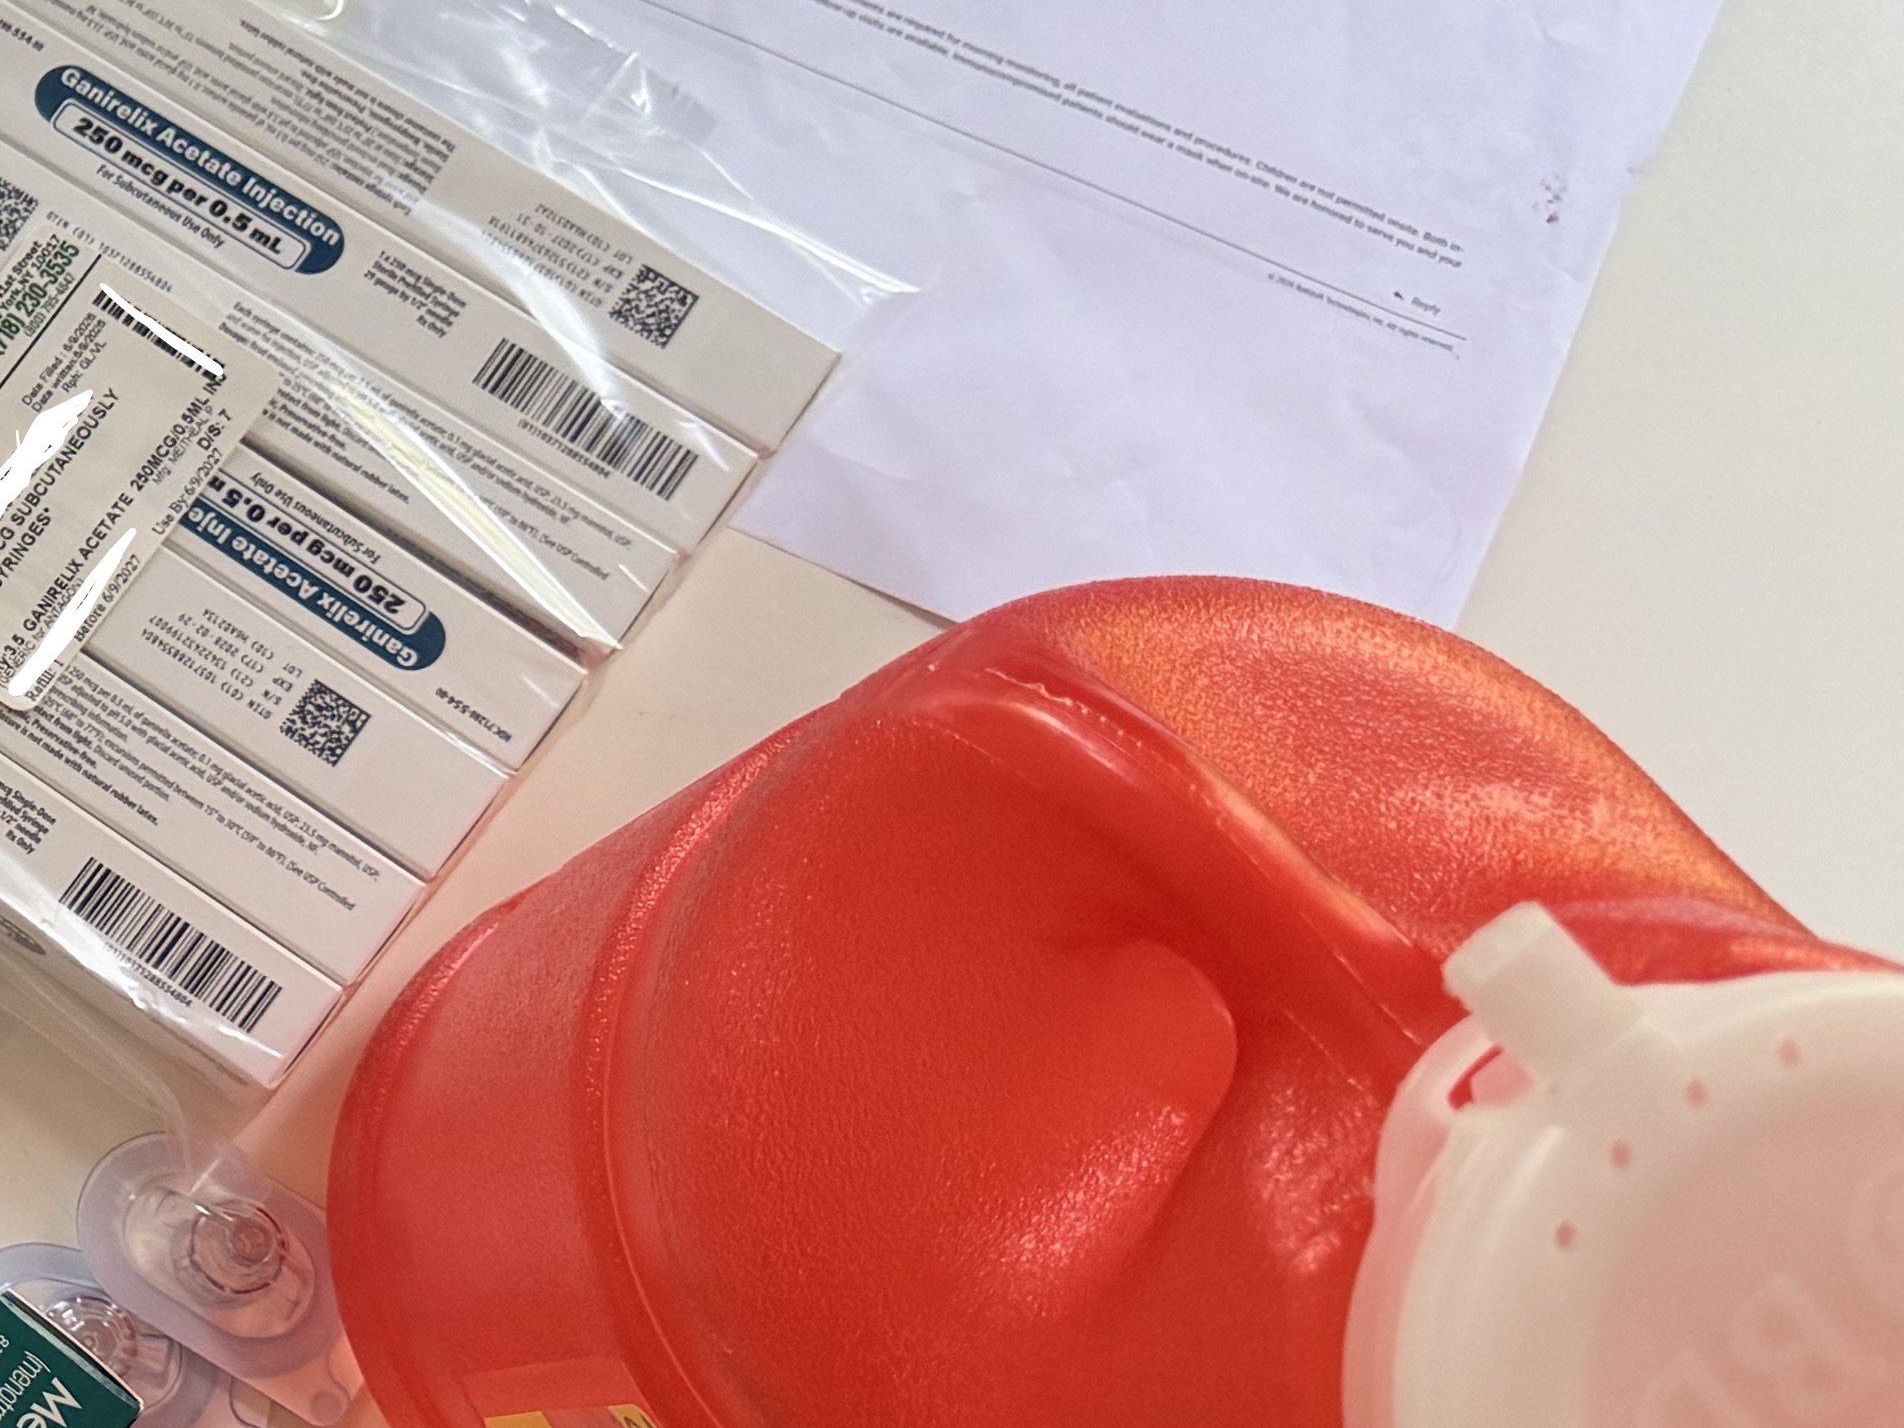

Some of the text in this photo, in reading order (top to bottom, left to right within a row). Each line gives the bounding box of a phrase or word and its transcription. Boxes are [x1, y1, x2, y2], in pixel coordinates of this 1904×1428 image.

[61, 68, 340, 246] Ganirelix Acetate Injection
[73, 117, 282, 255] 250 mcg per 0.5 mL
